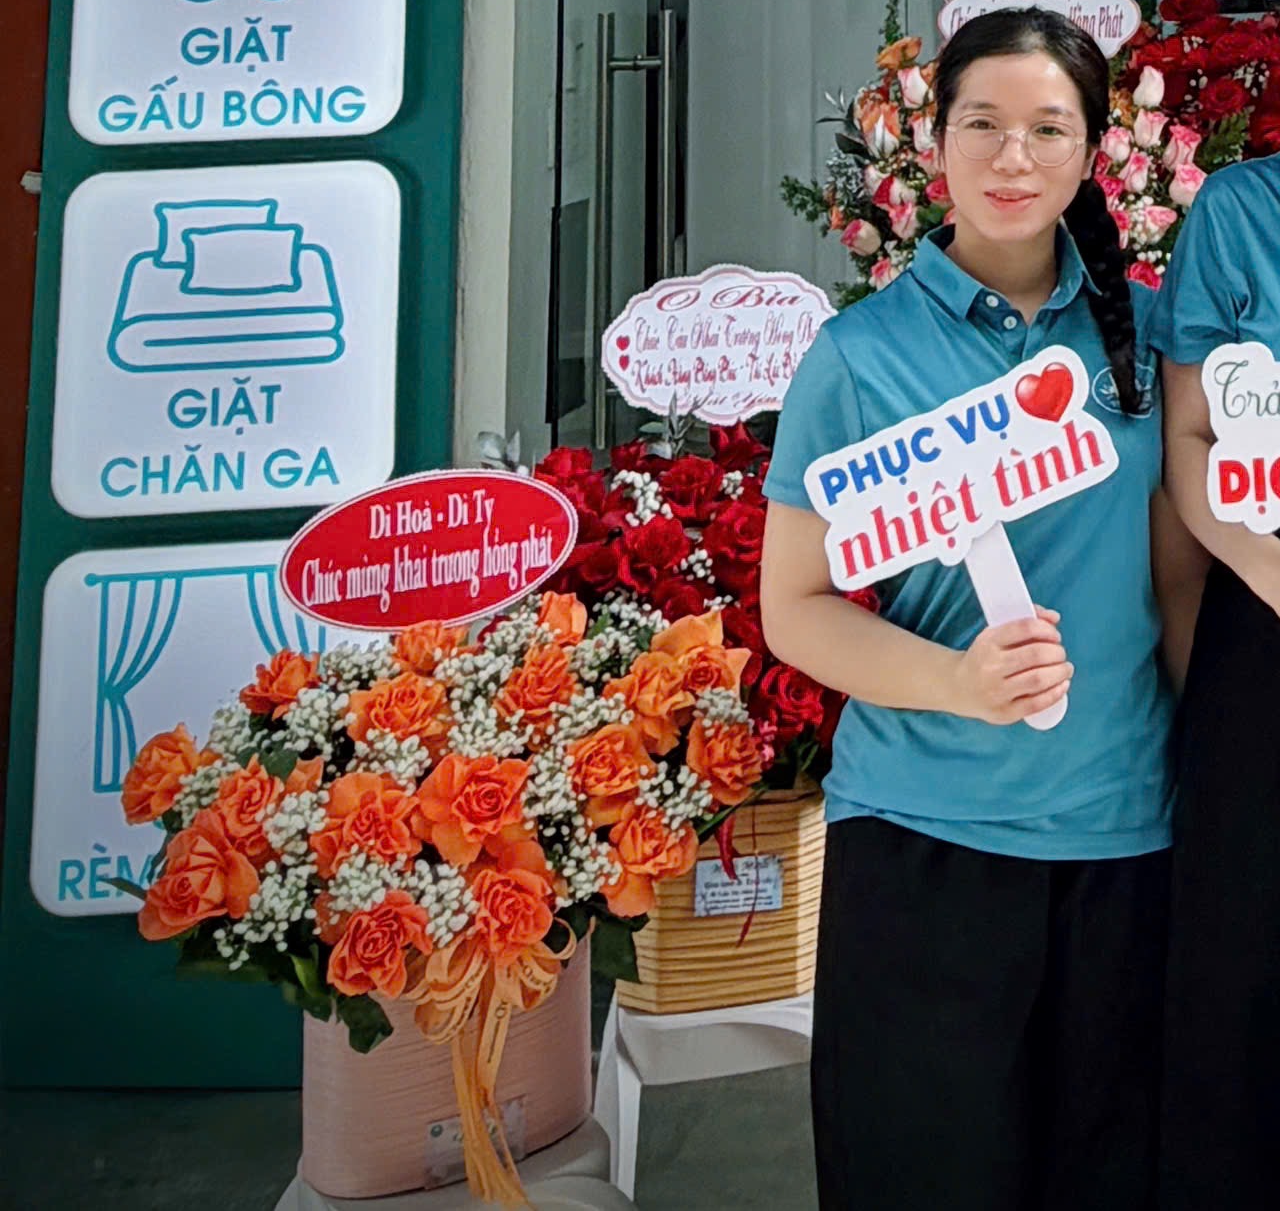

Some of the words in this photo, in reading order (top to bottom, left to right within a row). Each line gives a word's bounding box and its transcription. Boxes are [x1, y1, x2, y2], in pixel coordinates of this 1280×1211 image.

[180, 17, 292, 72] GIẶT
[98, 75, 205, 133] GẤU
[222, 79, 366, 128] BÔNG
[167, 376, 282, 436] GIẶT
[100, 444, 245, 498] CHĂN
[263, 446, 340, 489] GA
[819, 427, 942, 506] PHỤC
[945, 393, 1011, 445] VỤ
[369, 504, 391, 540] Dì
[447, 493, 469, 528] Dì
[838, 473, 983, 579] nhiệt
[992, 420, 1105, 508] tình
[302, 557, 343, 607] Chúc
[393, 544, 428, 593] khai
[521, 523, 553, 587] phát
